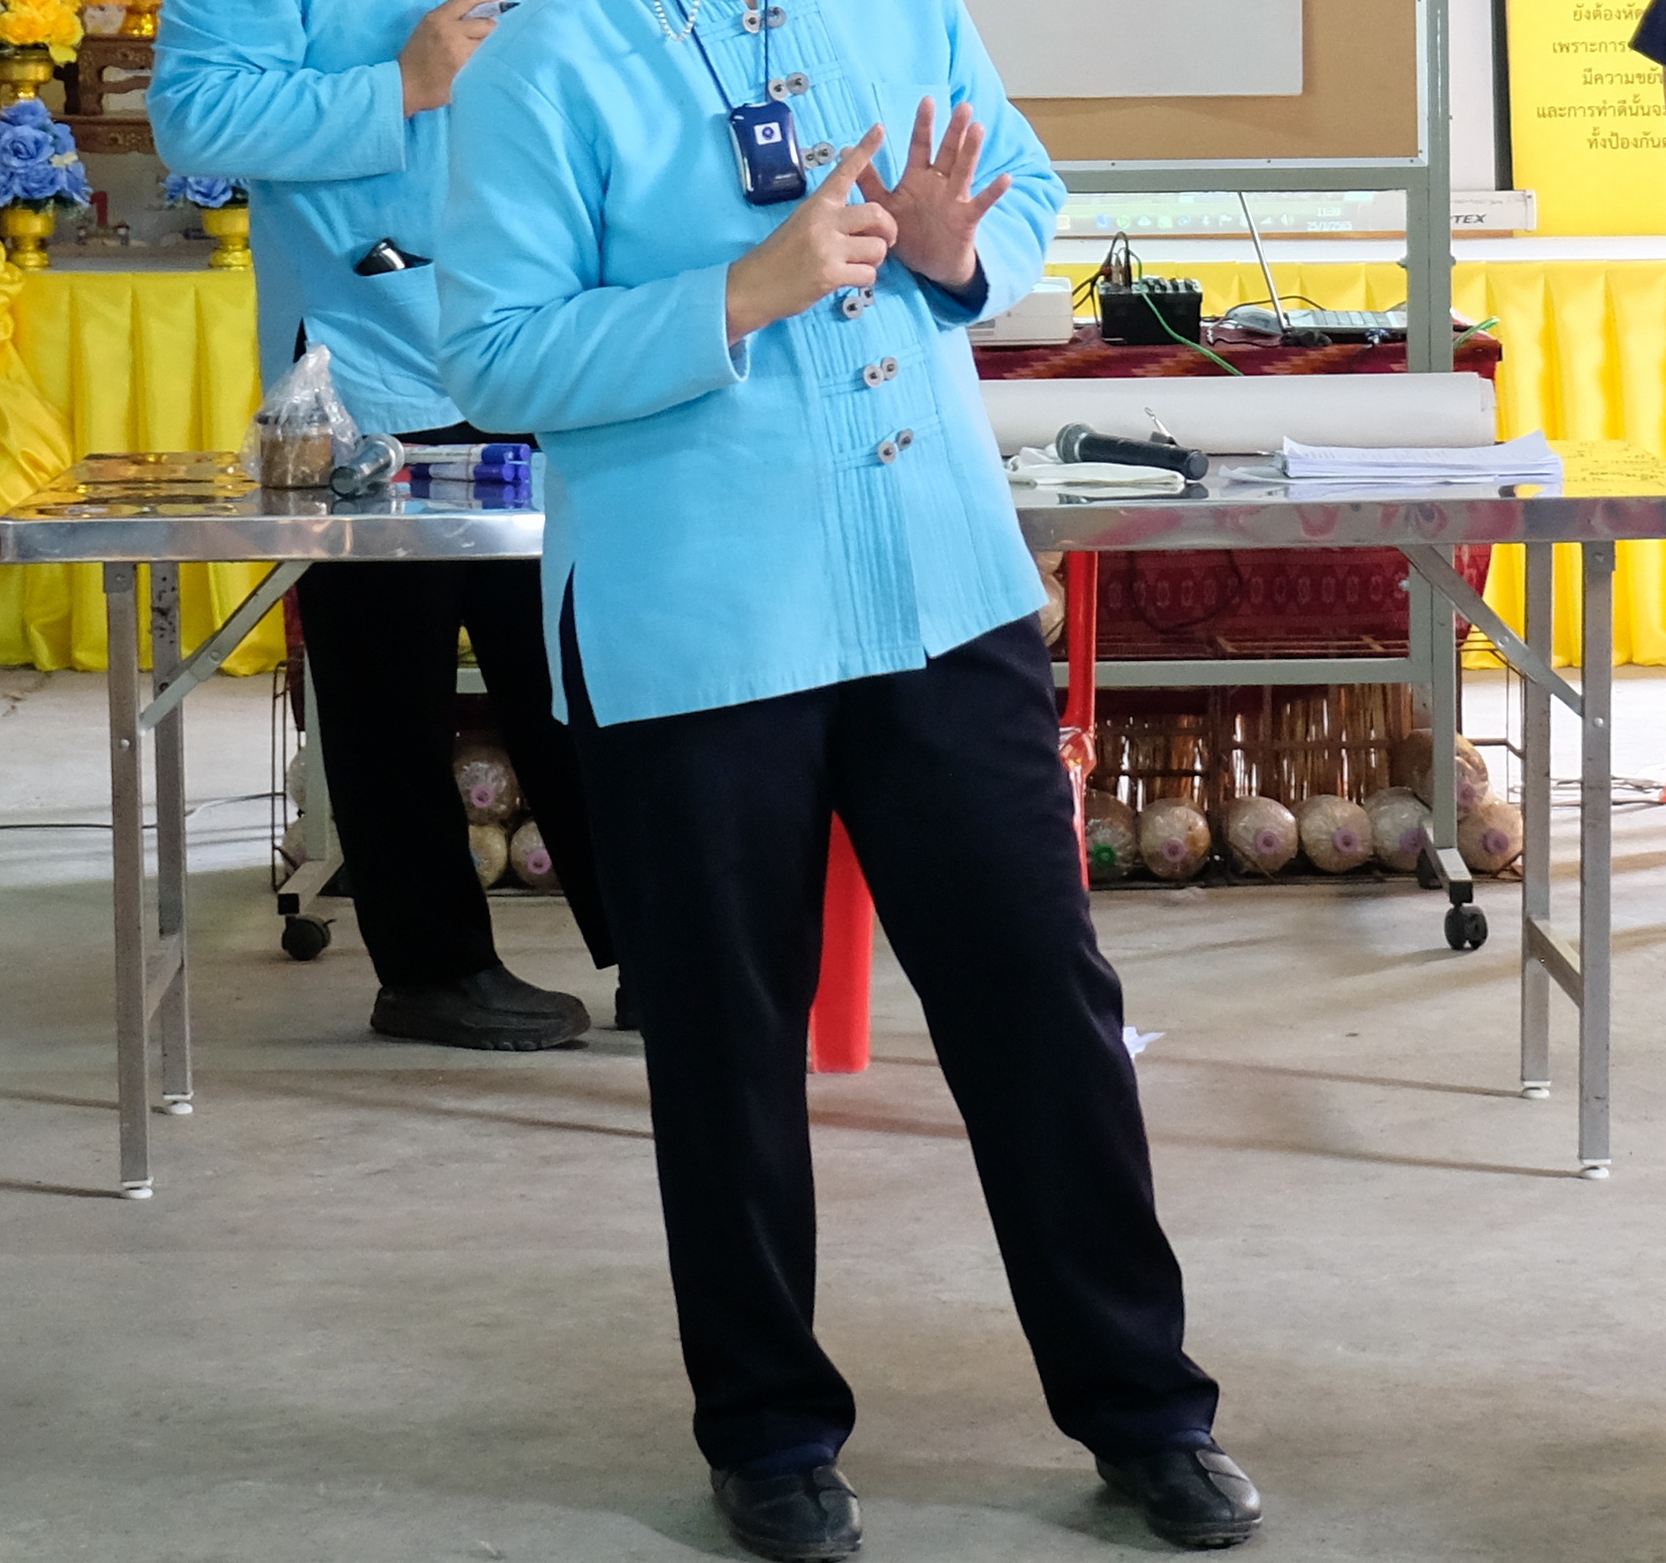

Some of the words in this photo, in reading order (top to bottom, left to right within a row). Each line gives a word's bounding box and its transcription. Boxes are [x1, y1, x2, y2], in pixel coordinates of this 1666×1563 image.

[1552, 40, 1631, 54] เพราะการ
[1451, 214, 1487, 224] TEX
